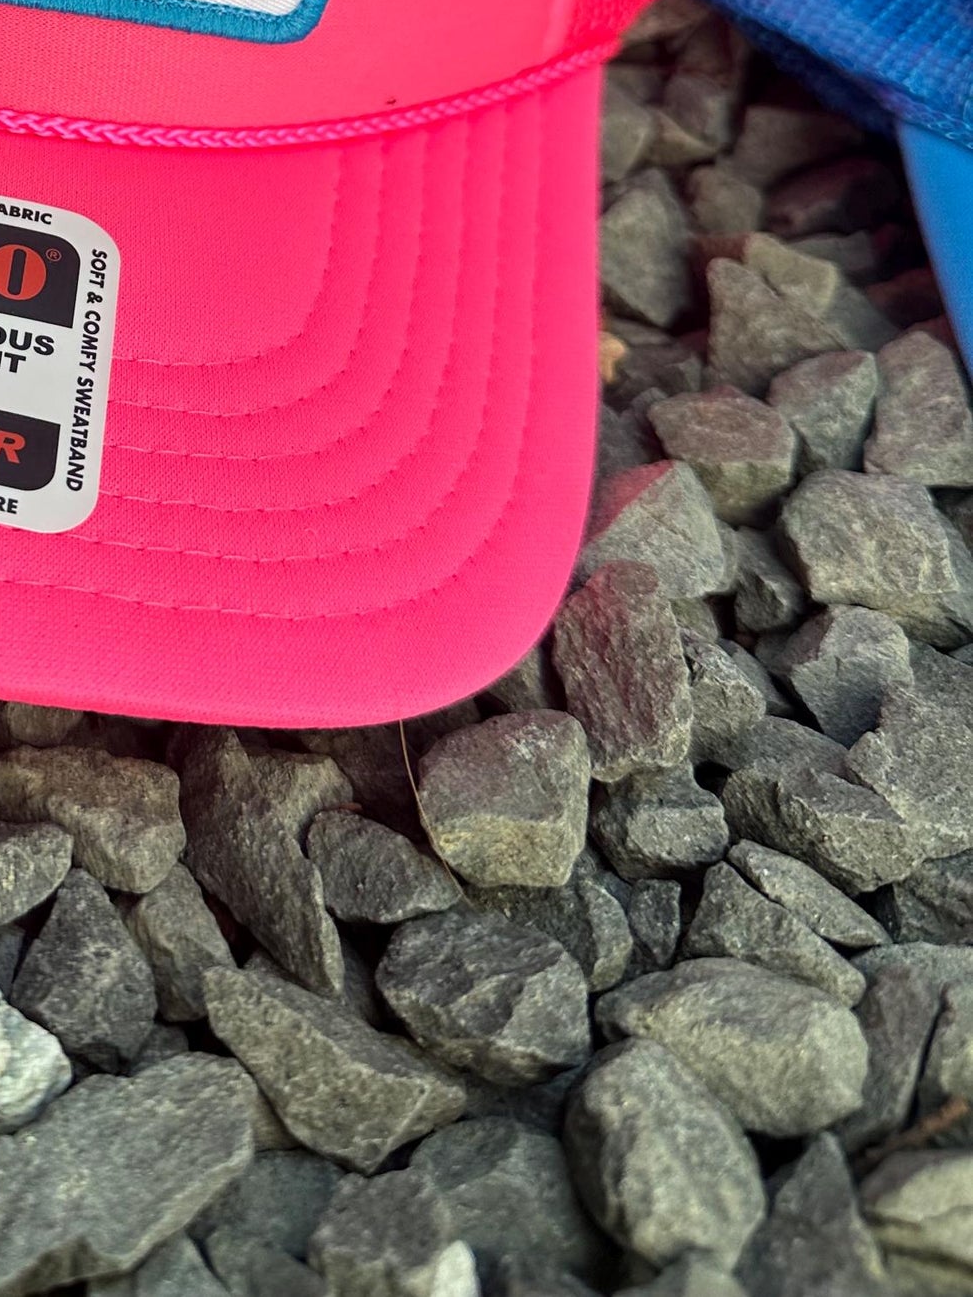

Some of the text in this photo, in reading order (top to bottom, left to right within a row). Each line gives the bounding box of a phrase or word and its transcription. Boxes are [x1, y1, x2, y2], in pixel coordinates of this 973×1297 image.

[66, 249, 107, 492] SOFT & COMFY SWEATBAND
